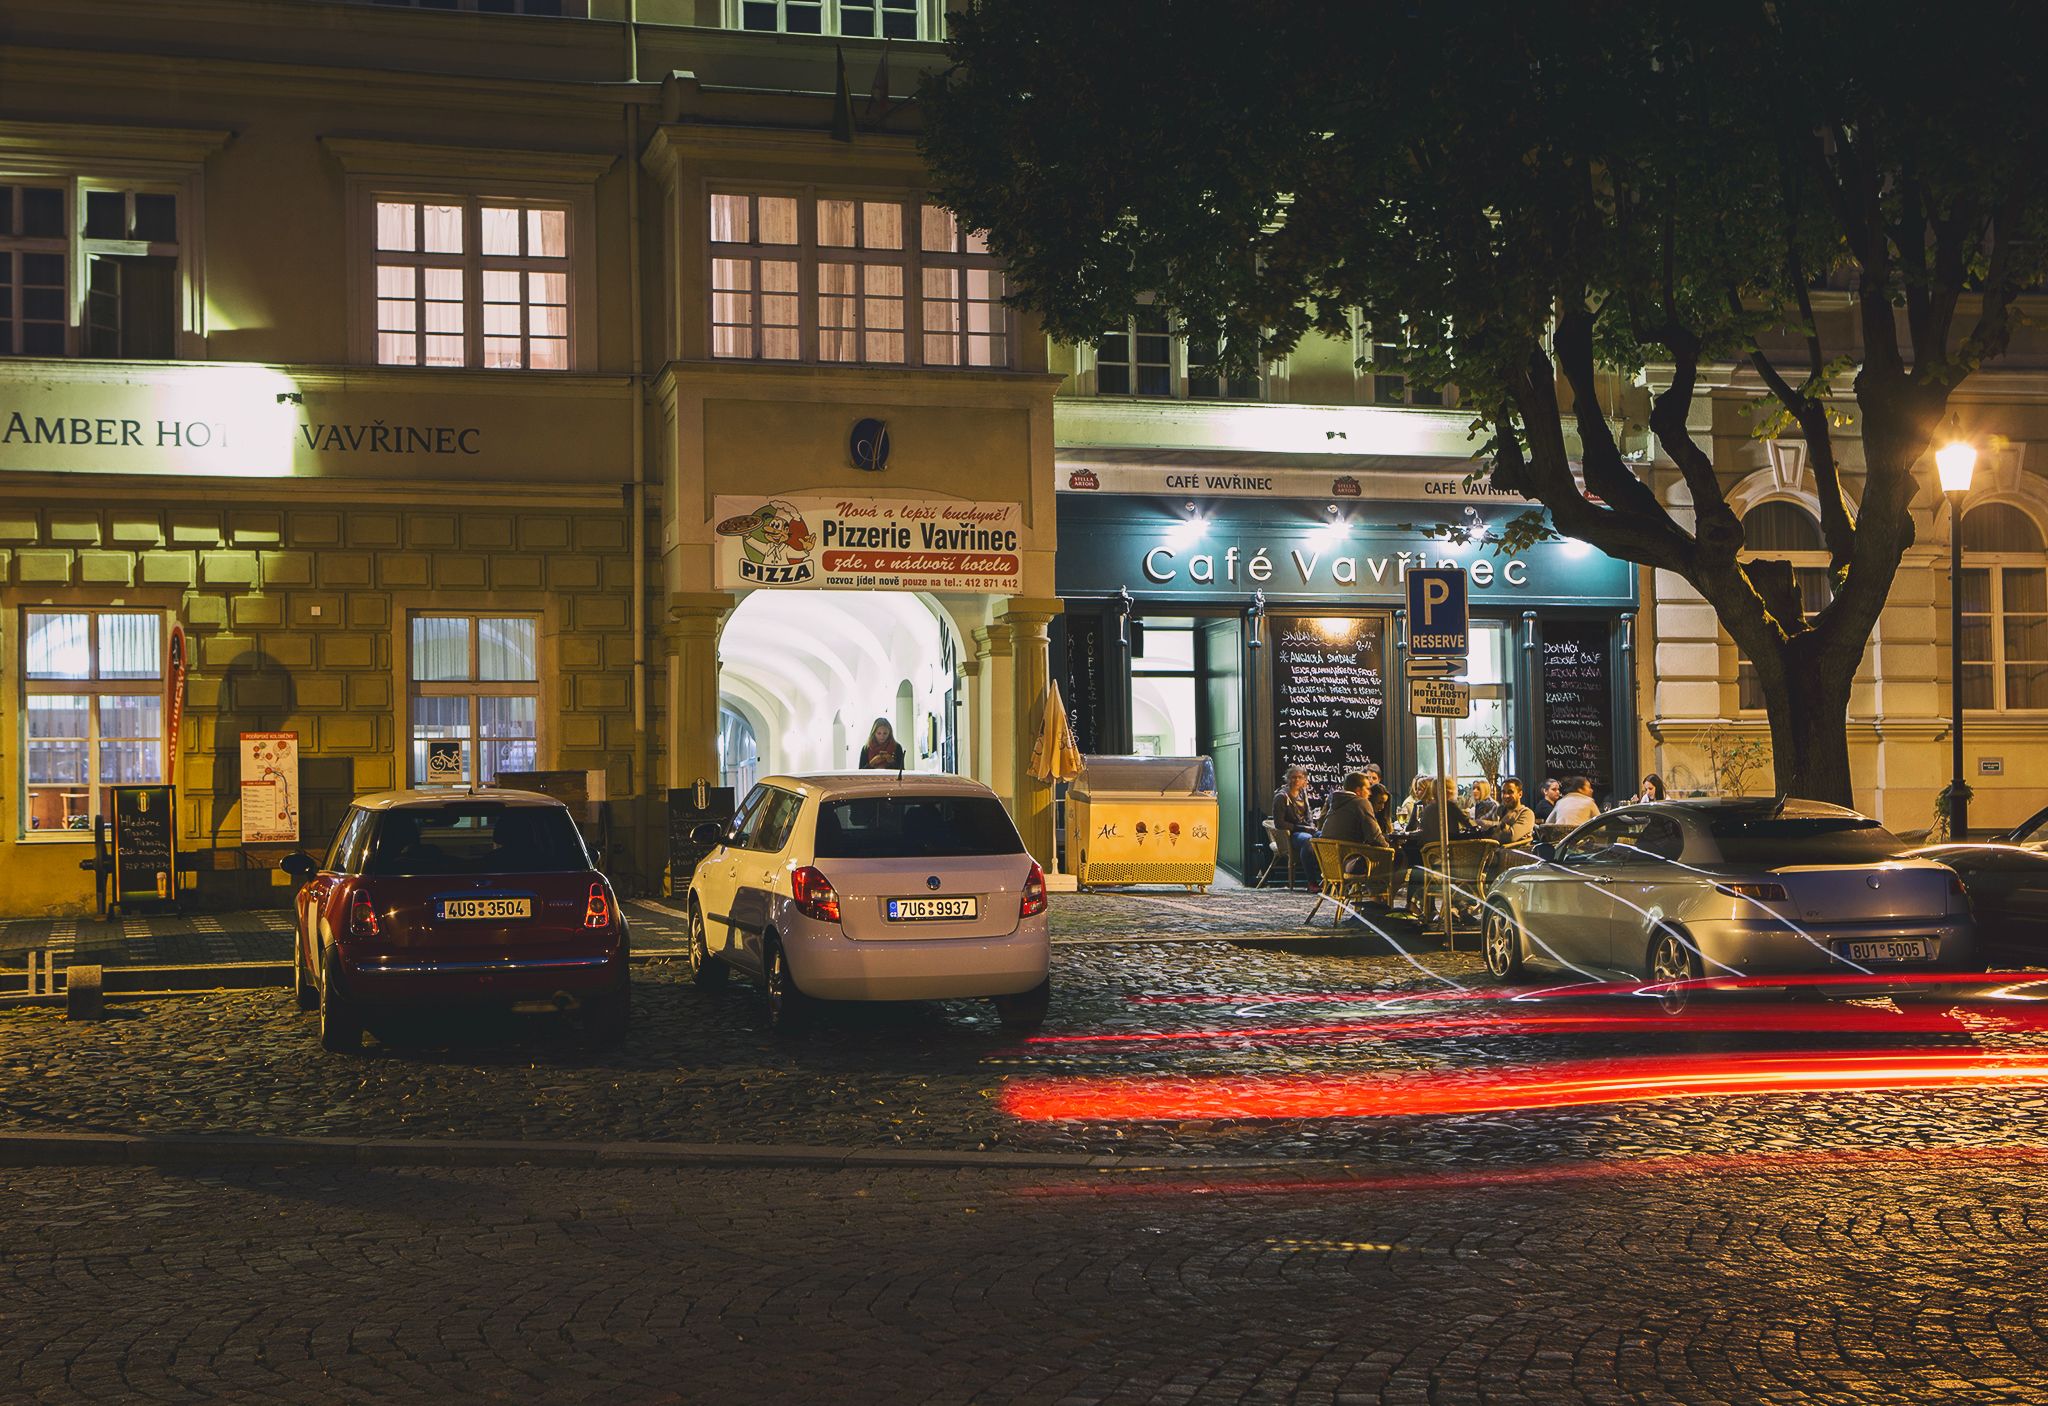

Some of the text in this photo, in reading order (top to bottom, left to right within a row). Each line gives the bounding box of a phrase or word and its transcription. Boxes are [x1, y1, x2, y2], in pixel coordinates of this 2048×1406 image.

[2, 411, 143, 447] AMBER
[300, 419, 481, 455] VAVŘINEC
[1166, 473, 1273, 491] CAFÉ VAVŘINEC
[1424, 480, 1457, 495] CAFÉ
[835, 501, 1009, 525] Nová a lepší kuchyně!
[822, 519, 1017, 552] Pizzerie Vavřinec
[833, 555, 1012, 573] zde, v nádvoří hotelu
[1147, 546, 1273, 583] Café
[742, 564, 812, 583] PIZZA
[826, 577, 853, 586] rozvoz
[855, 575, 876, 588] jídel
[878, 576, 900, 586] nově
[902, 578, 927, 589] pouze
[929, 579, 942, 588] na
[965, 577, 980, 588] 412
[983, 577, 999, 588] 871
[1001, 578, 1018, 589] 412
[1423, 578, 1450, 626] P
[1425, 698, 1456, 706] HOTELU
[1546, 744, 1578, 755] MOJITO
[448, 902, 476, 918] 4U9
[487, 901, 524, 916] 3504
[900, 901, 926, 917] 7U6
[936, 900, 969, 916] 9937
[1853, 942, 1920, 958] 8U1 5005
